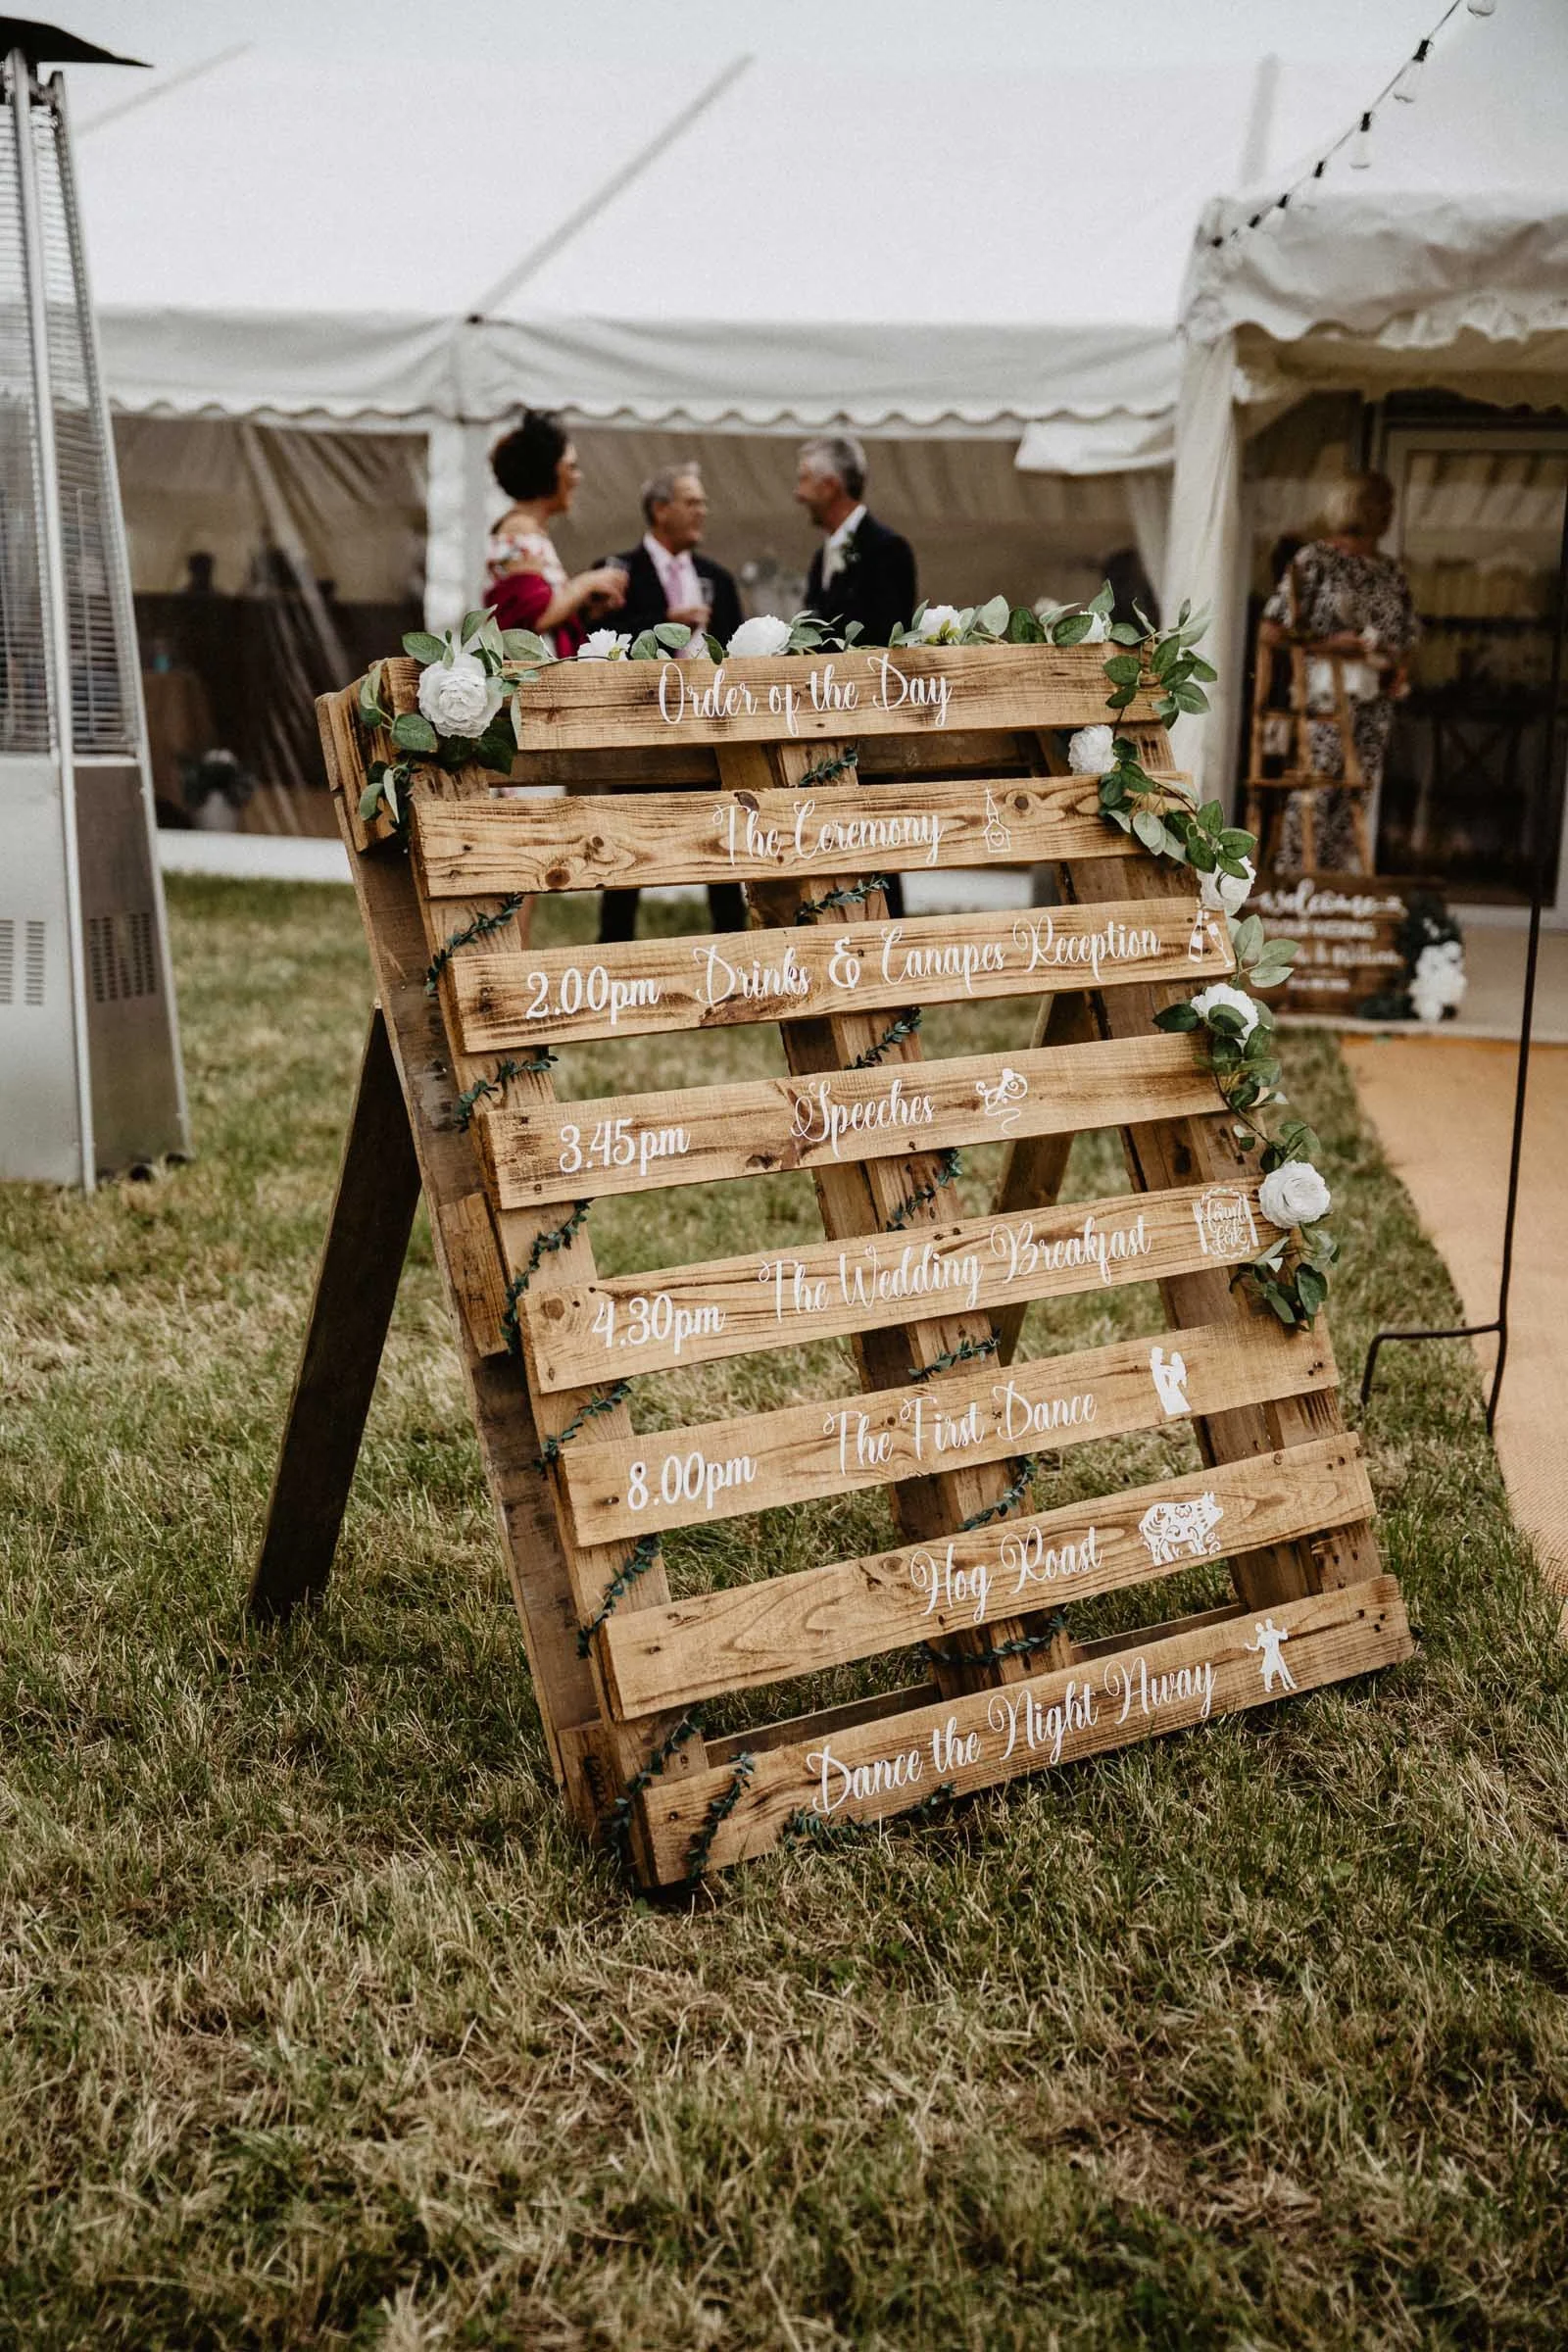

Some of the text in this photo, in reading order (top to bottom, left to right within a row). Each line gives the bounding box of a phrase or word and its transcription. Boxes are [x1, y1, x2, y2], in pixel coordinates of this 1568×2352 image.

[659, 654, 953, 737] Order of the Day
[712, 800, 945, 866] The Ceremony
[526, 915, 1161, 1025] 2.00pm Drinks & Canapes Reception
[559, 1079, 935, 1176] 3.45pm Speeches
[592, 1215, 1152, 1355] 4.30pm The Wedding Breakfast
[627, 1380, 1099, 1510] 8.00pm The First Dance
[910, 1526, 1103, 1623] Hog Roast
[806, 1656, 1217, 1815] Dance the Night Away
